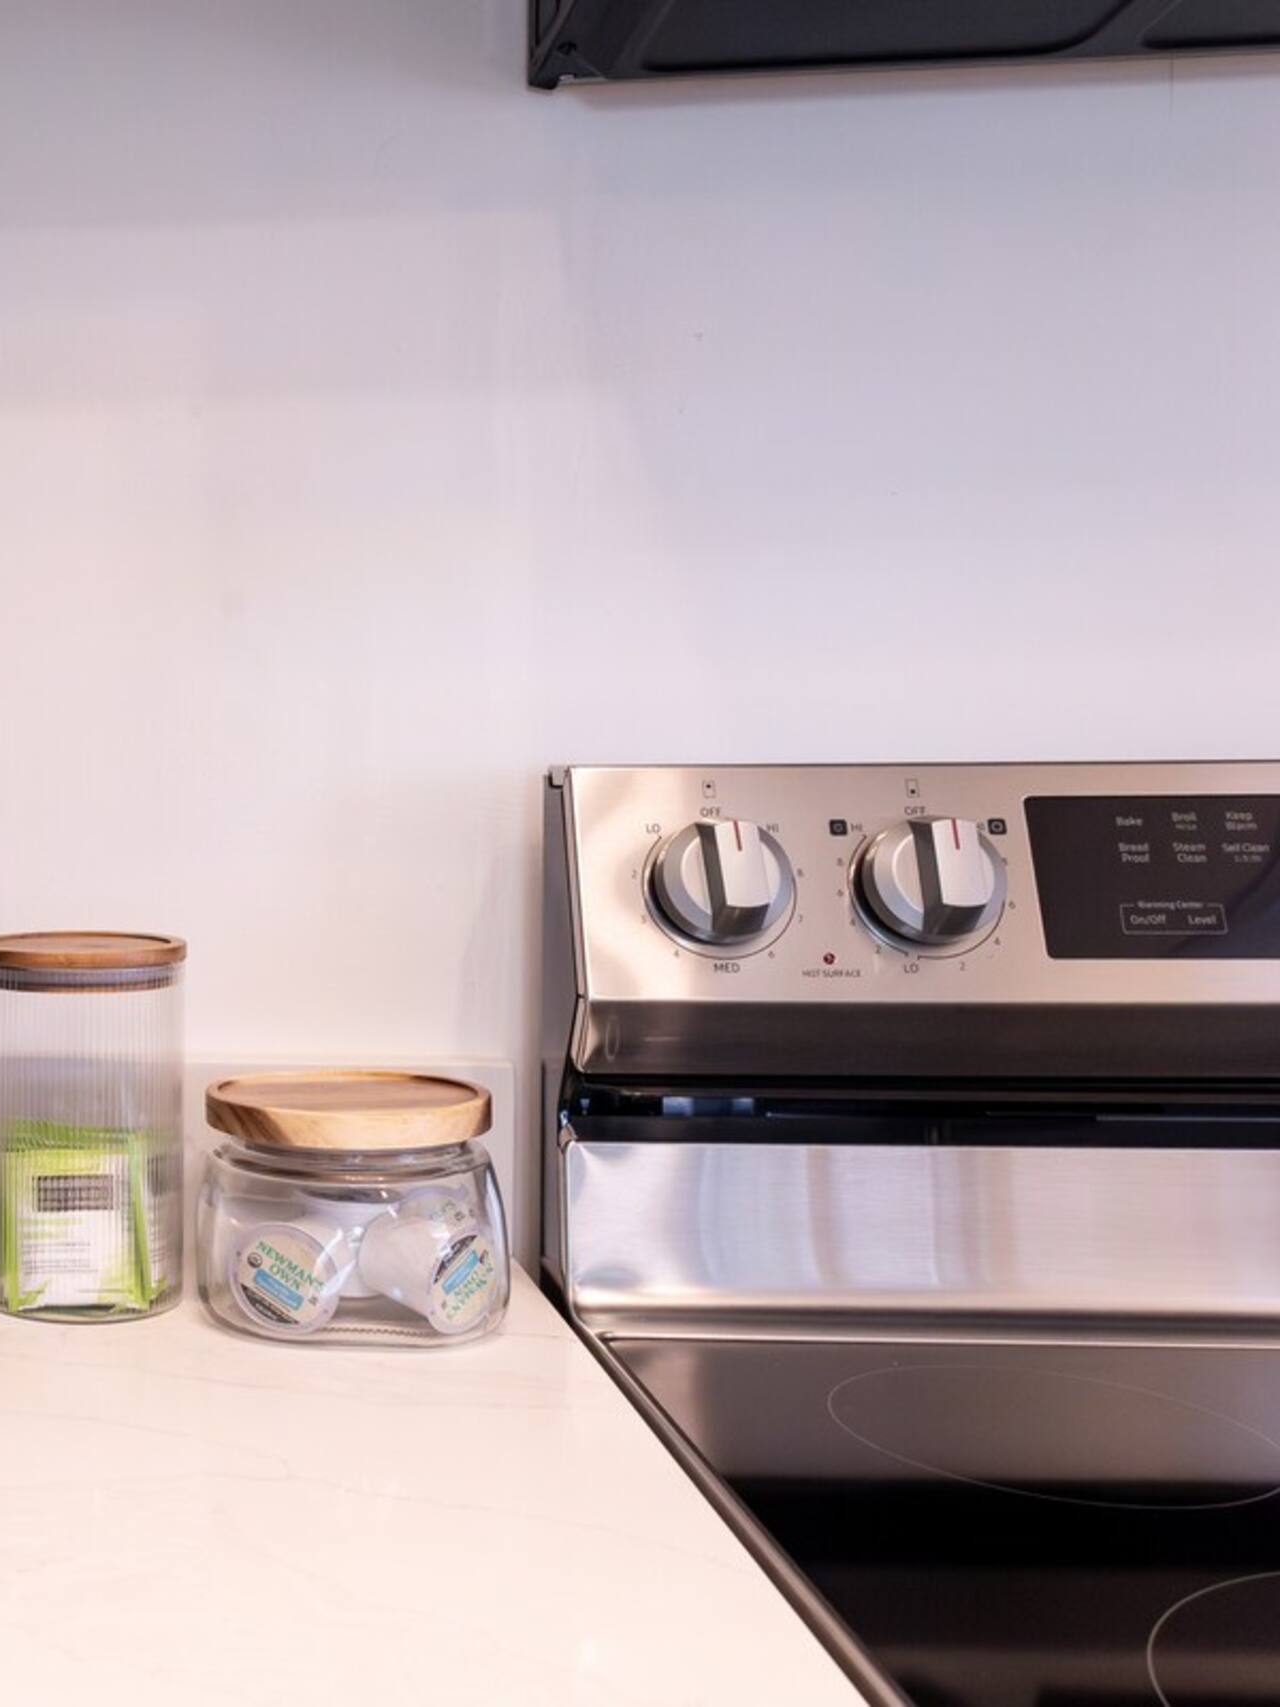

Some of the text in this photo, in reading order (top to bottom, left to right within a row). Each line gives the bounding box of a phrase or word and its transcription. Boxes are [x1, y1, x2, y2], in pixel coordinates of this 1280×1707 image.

[700, 807, 721, 817] OFF
[904, 806, 925, 816] OFF
[1116, 816, 1143, 826] Bake
[1171, 812, 1197, 822] Broil
[1224, 812, 1253, 821] Keep
[646, 824, 661, 834] LO
[1118, 842, 1150, 852] Bread
[1172, 842, 1206, 852] Steam
[1241, 842, 1270, 852] Clean
[1121, 853, 1150, 863] Proof
[1177, 853, 1208, 863] Clean
[1130, 915, 1167, 925] On/Off
[1188, 915, 1217, 925] Level
[714, 963, 740, 974] MED
[904, 963, 919, 973] LO
